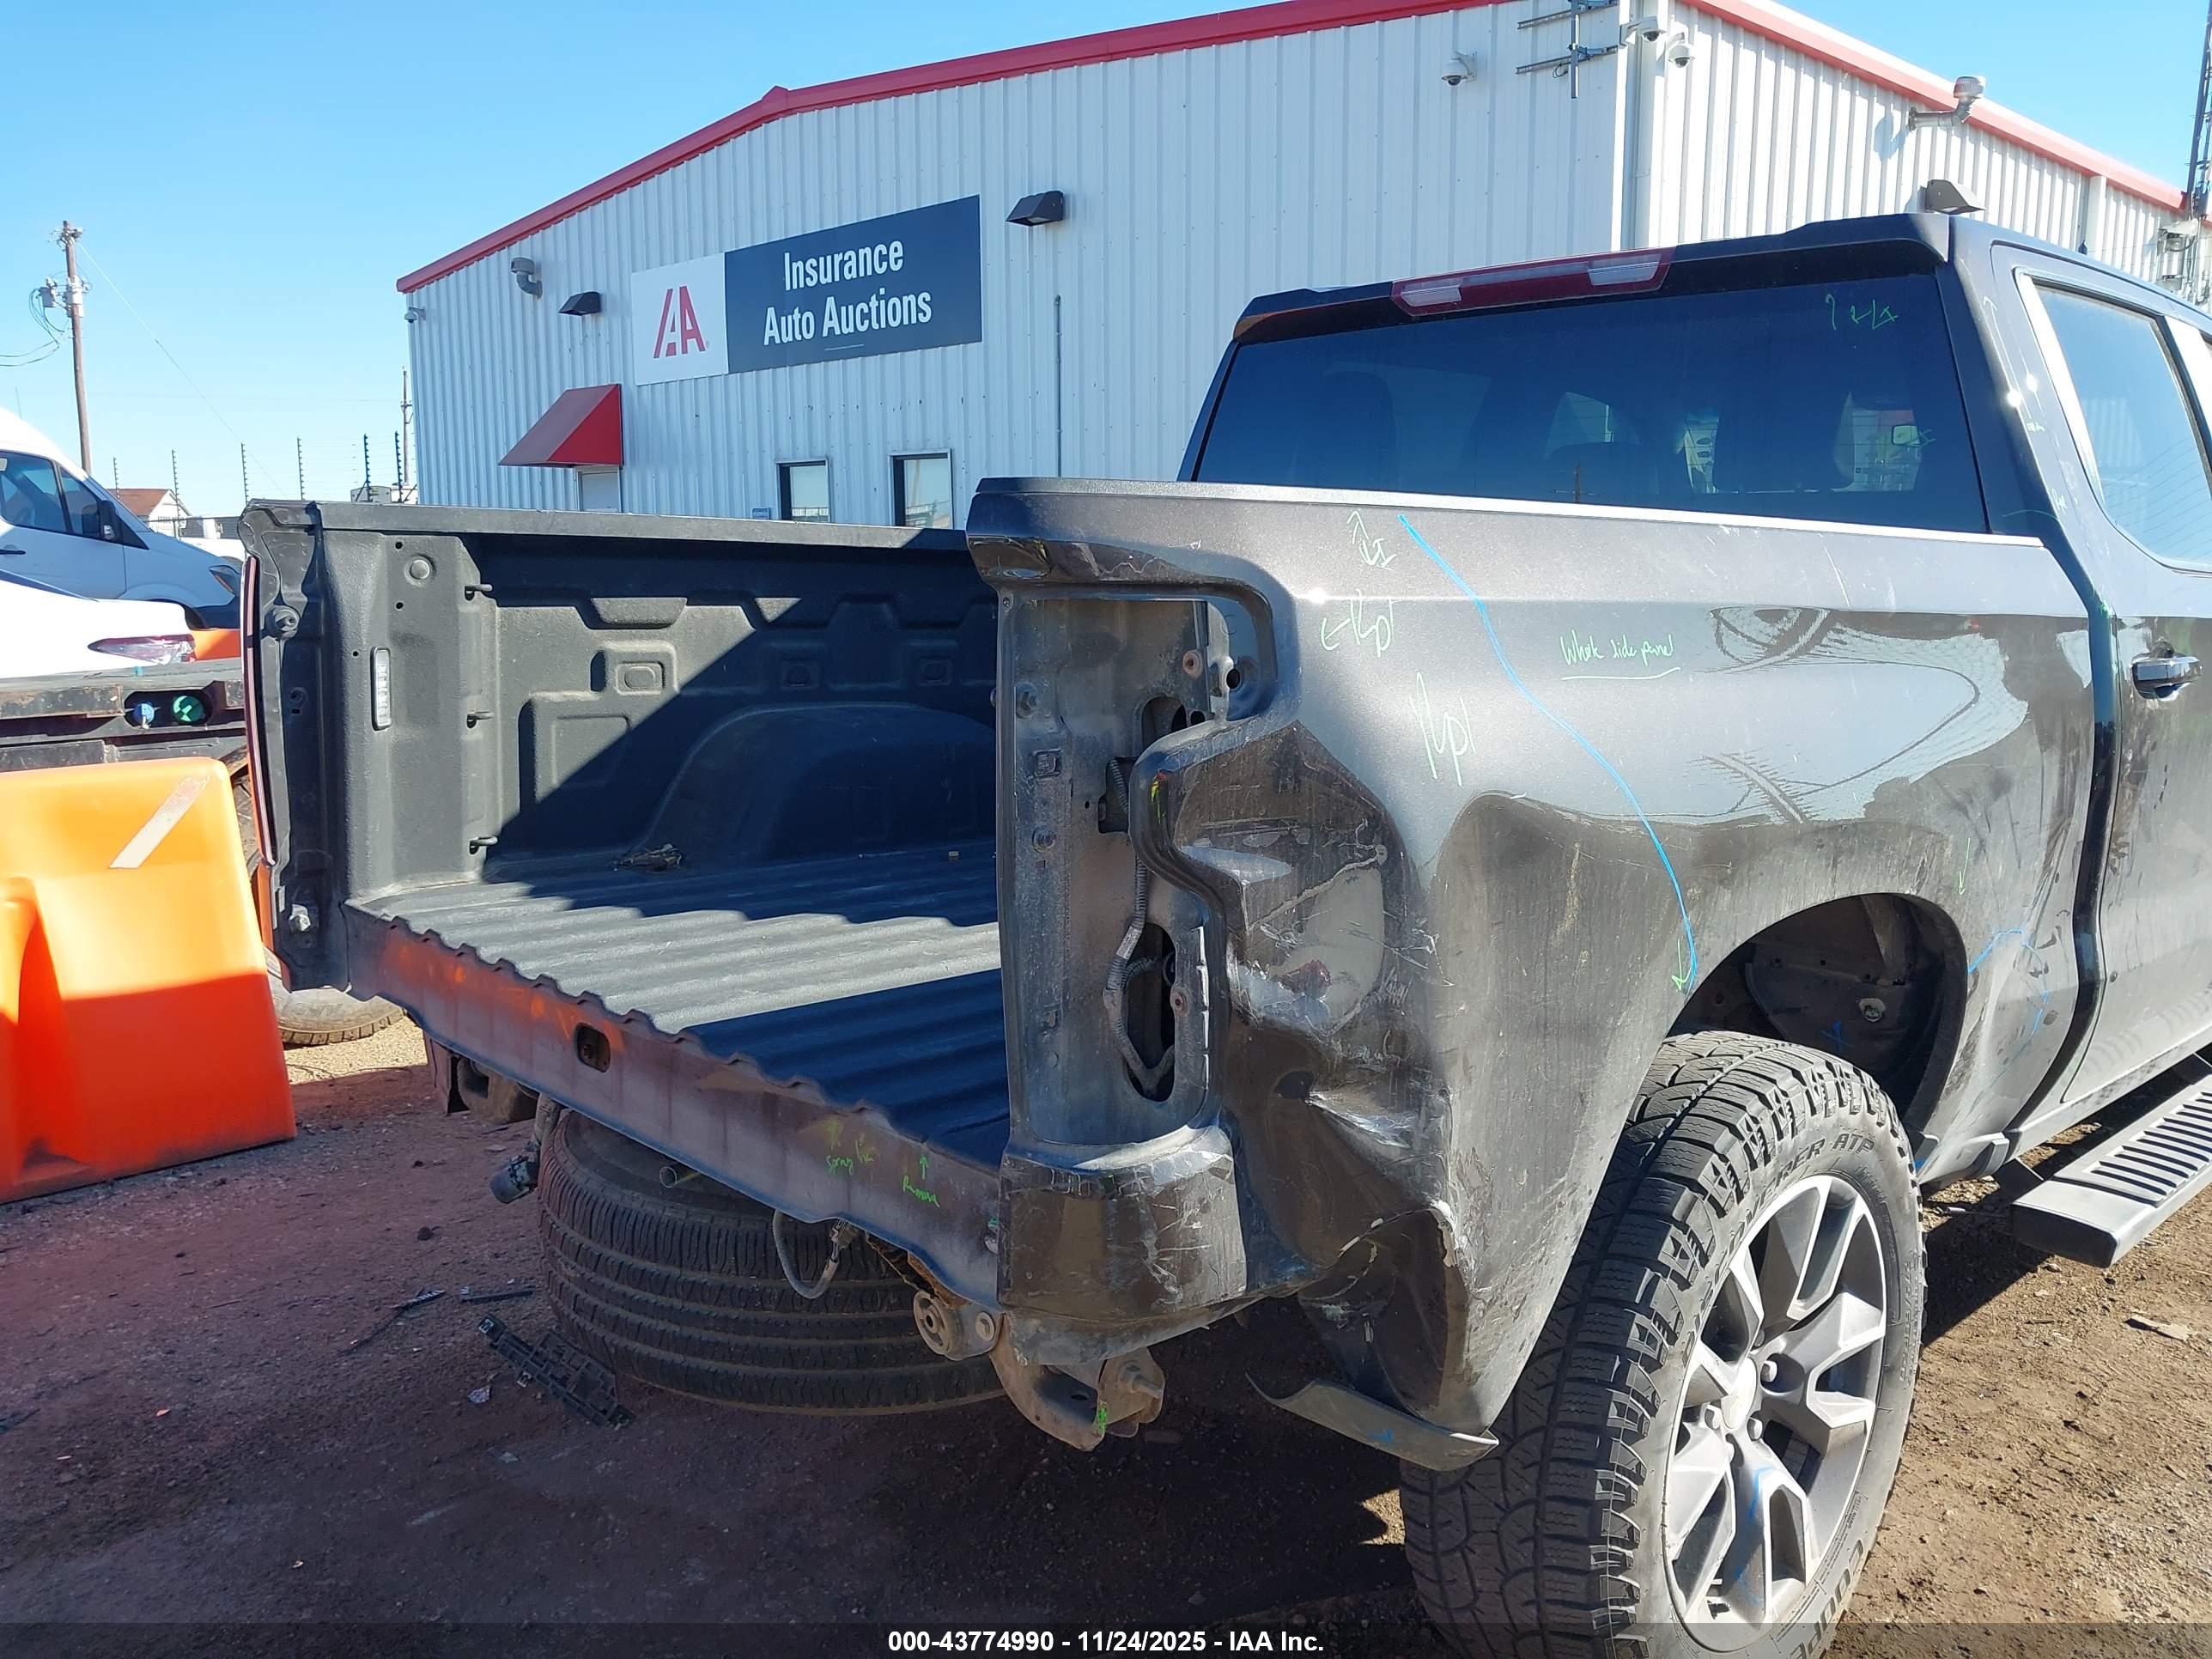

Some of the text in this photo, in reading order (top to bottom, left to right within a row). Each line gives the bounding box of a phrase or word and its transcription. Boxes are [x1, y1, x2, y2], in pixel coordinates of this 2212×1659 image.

[783, 240, 904, 292] Insurance
[763, 288, 933, 346] Auto Auctions
[1832, 1133, 1875, 1155] ATP
